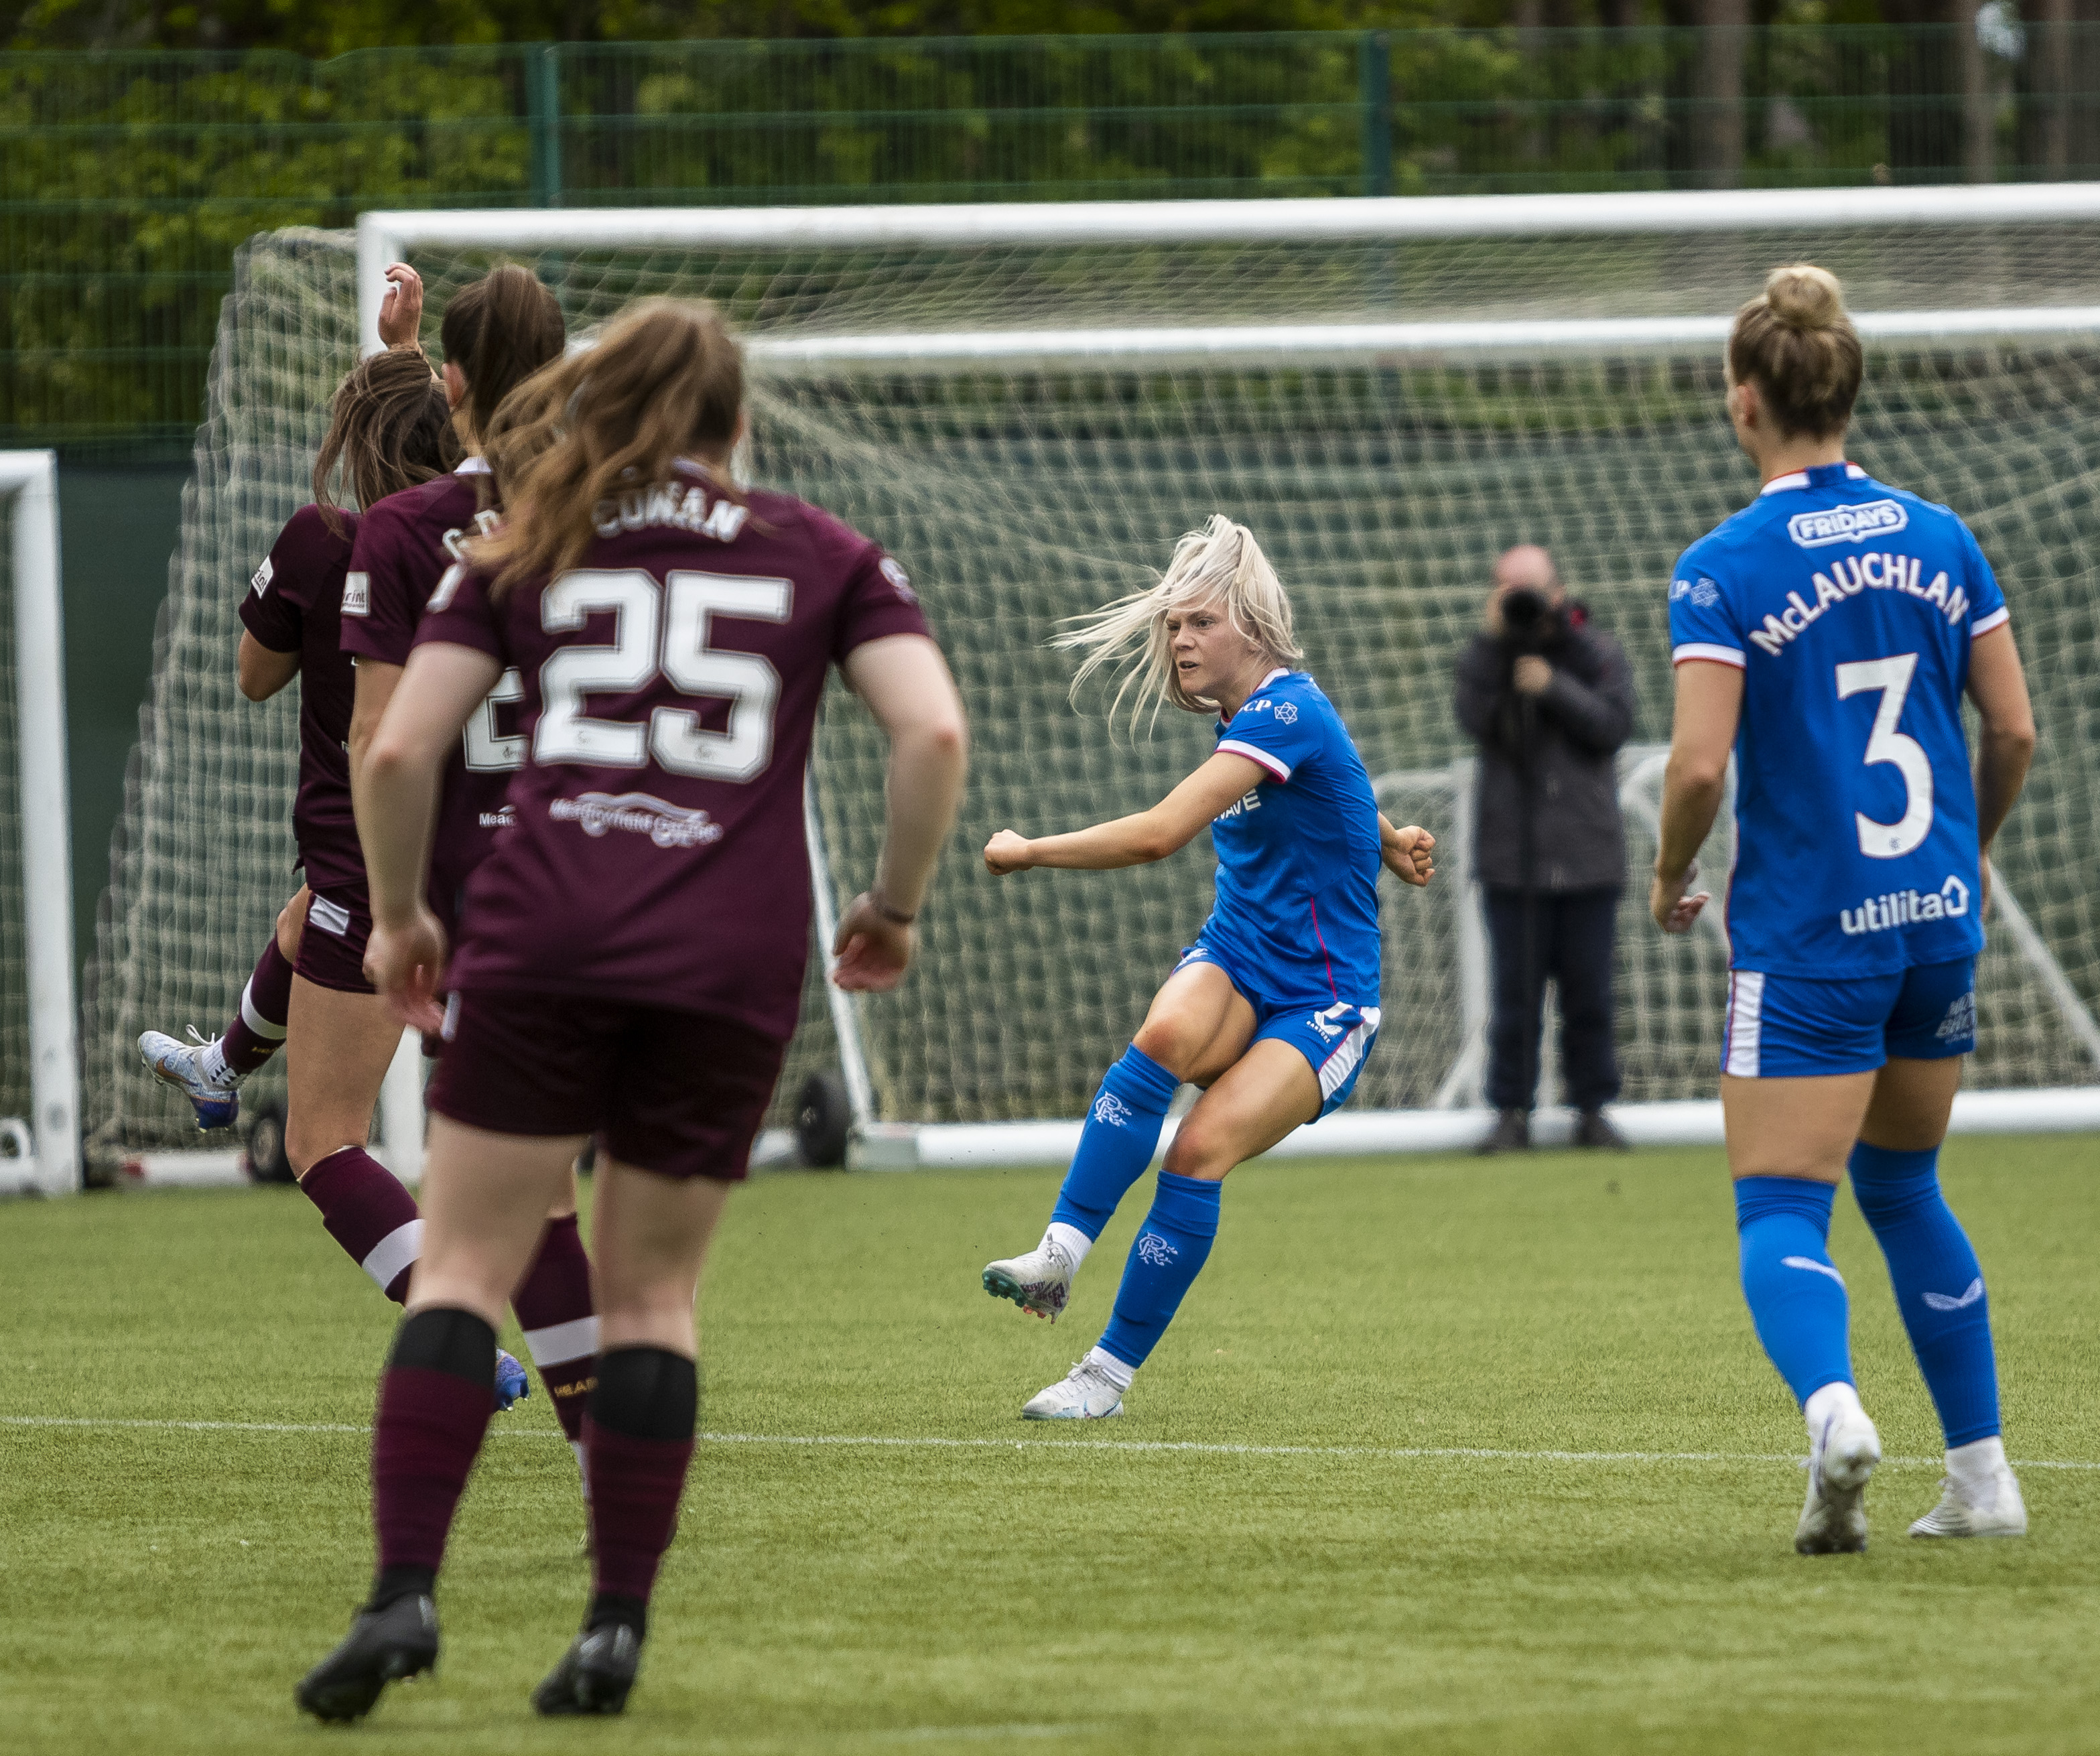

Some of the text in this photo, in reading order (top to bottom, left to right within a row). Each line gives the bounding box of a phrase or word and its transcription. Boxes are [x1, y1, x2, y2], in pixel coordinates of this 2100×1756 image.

[1800, 501, 1899, 539] FRIDAYS
[1748, 552, 1970, 657] McLAUCHLAN
[533, 567, 795, 784] 25
[1835, 652, 1935, 860] 3
[1840, 888, 1945, 936] utilita
